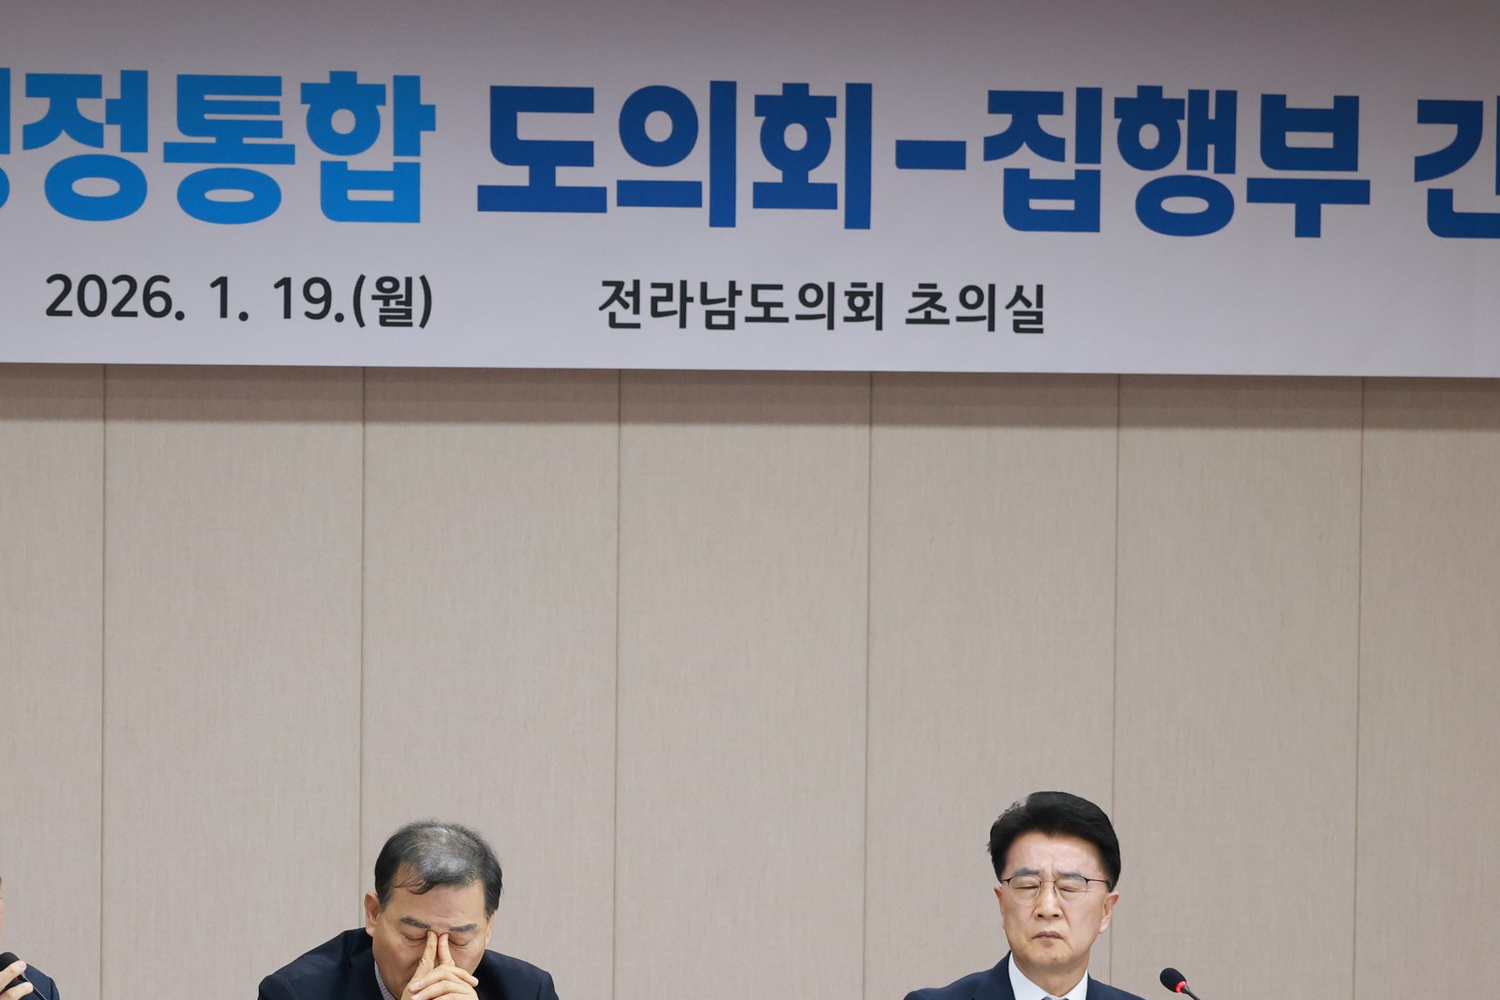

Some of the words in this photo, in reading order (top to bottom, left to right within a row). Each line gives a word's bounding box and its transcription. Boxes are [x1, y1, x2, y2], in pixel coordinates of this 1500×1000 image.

[45, 273, 186, 321] 2026.
[210, 275, 249, 322] 1.
[272, 275, 433, 329] 19.(월)
[598, 279, 884, 331] 전라남도의회
[905, 282, 1045, 335] 초의실
